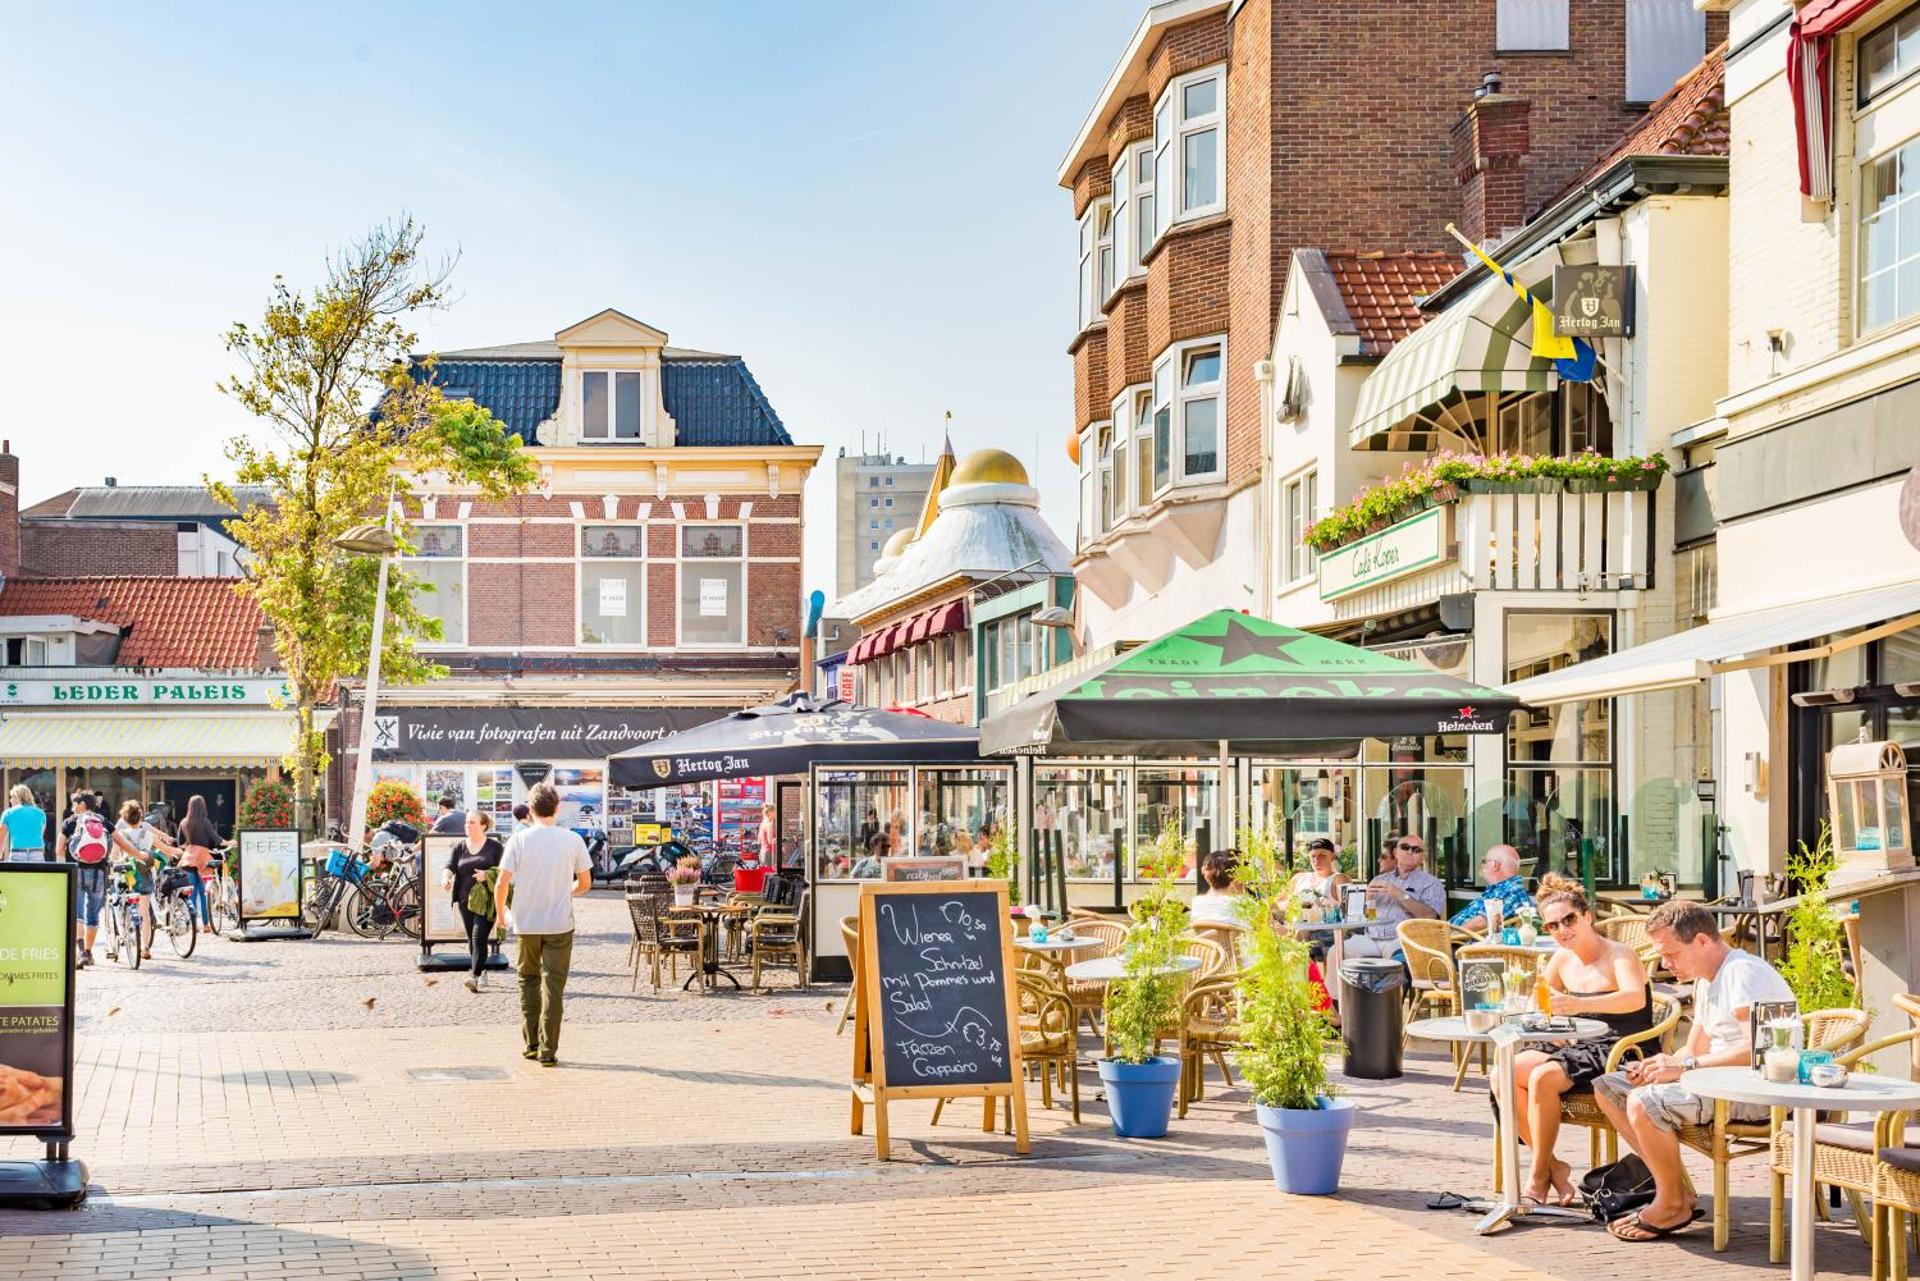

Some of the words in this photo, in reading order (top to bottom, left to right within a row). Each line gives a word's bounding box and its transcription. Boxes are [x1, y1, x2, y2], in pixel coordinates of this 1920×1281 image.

[1559, 316, 1598, 329] Hertog
[1599, 316, 1620, 328] Jan
[53, 685, 139, 700] LEDER
[153, 685, 246, 700] PALEIS
[408, 723, 444, 740] Visie
[448, 729, 475, 740] van
[476, 722, 556, 744] fotografen
[561, 724, 584, 740] uit
[585, 723, 665, 741] Zandvoort
[1437, 720, 1494, 732] Heineken
[676, 758, 723, 777] Hertog
[723, 755, 750, 774] Jan
[22, 946, 60, 961] FRIES
[920, 947, 984, 972] Schnitzel
[882, 973, 911, 989] mit
[913, 972, 969, 991] Pommes
[11, 1015, 59, 1027] PATATES
